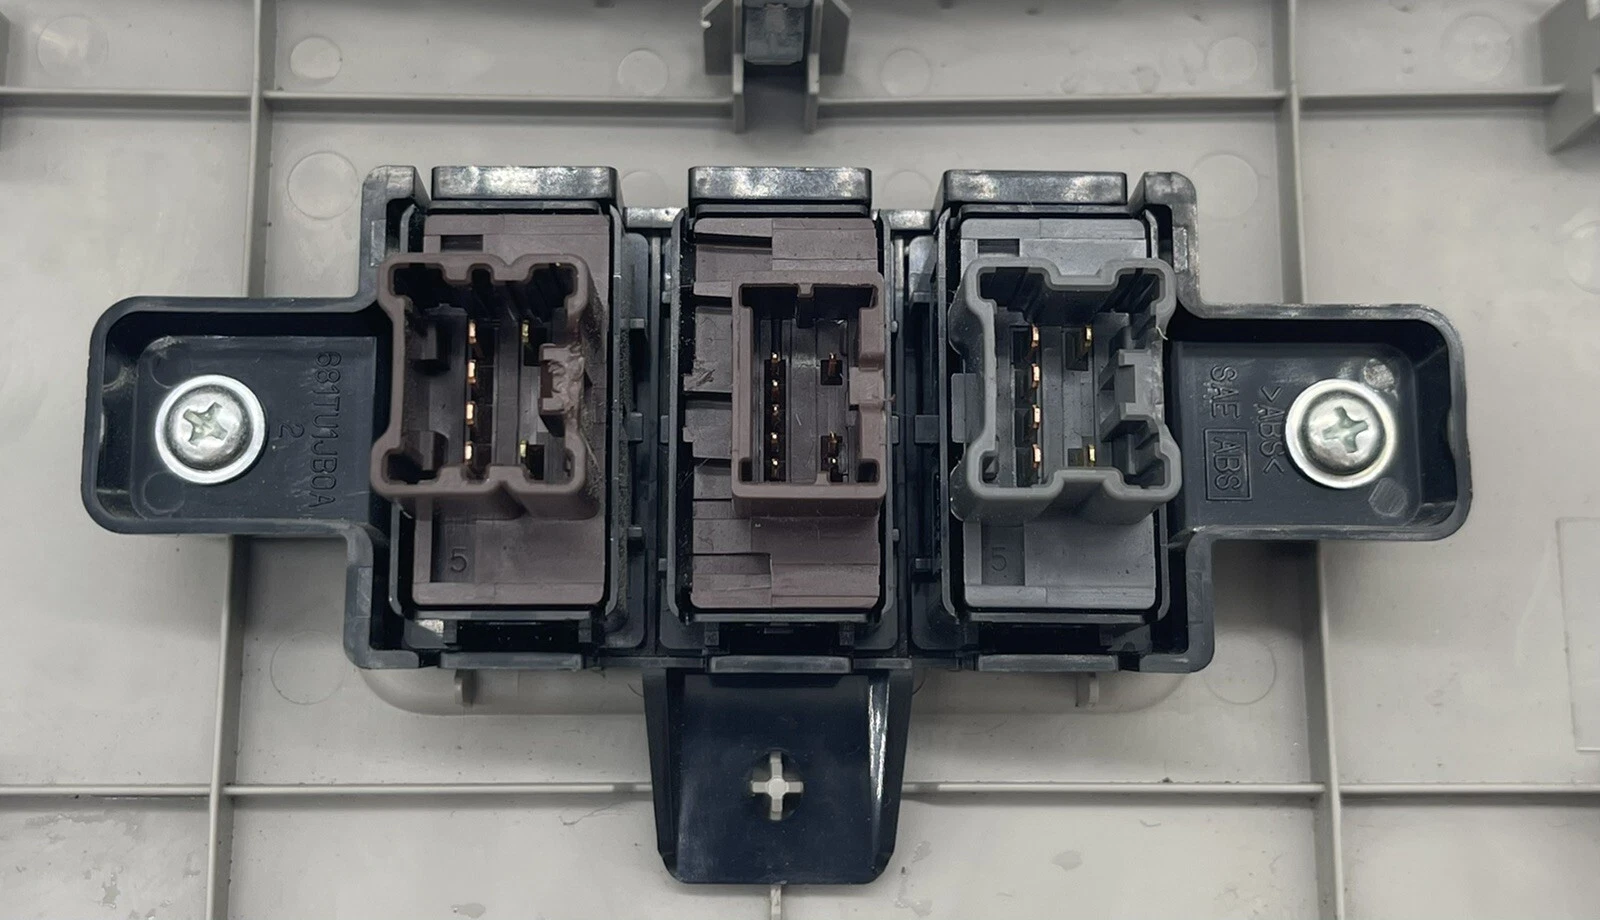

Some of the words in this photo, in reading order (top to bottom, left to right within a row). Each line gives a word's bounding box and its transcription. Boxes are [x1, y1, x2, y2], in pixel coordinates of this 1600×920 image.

[1210, 365, 1240, 419] SAE
[1213, 436, 1242, 490] ABS
[450, 547, 468, 573] 5
[990, 546, 1008, 572] 5
